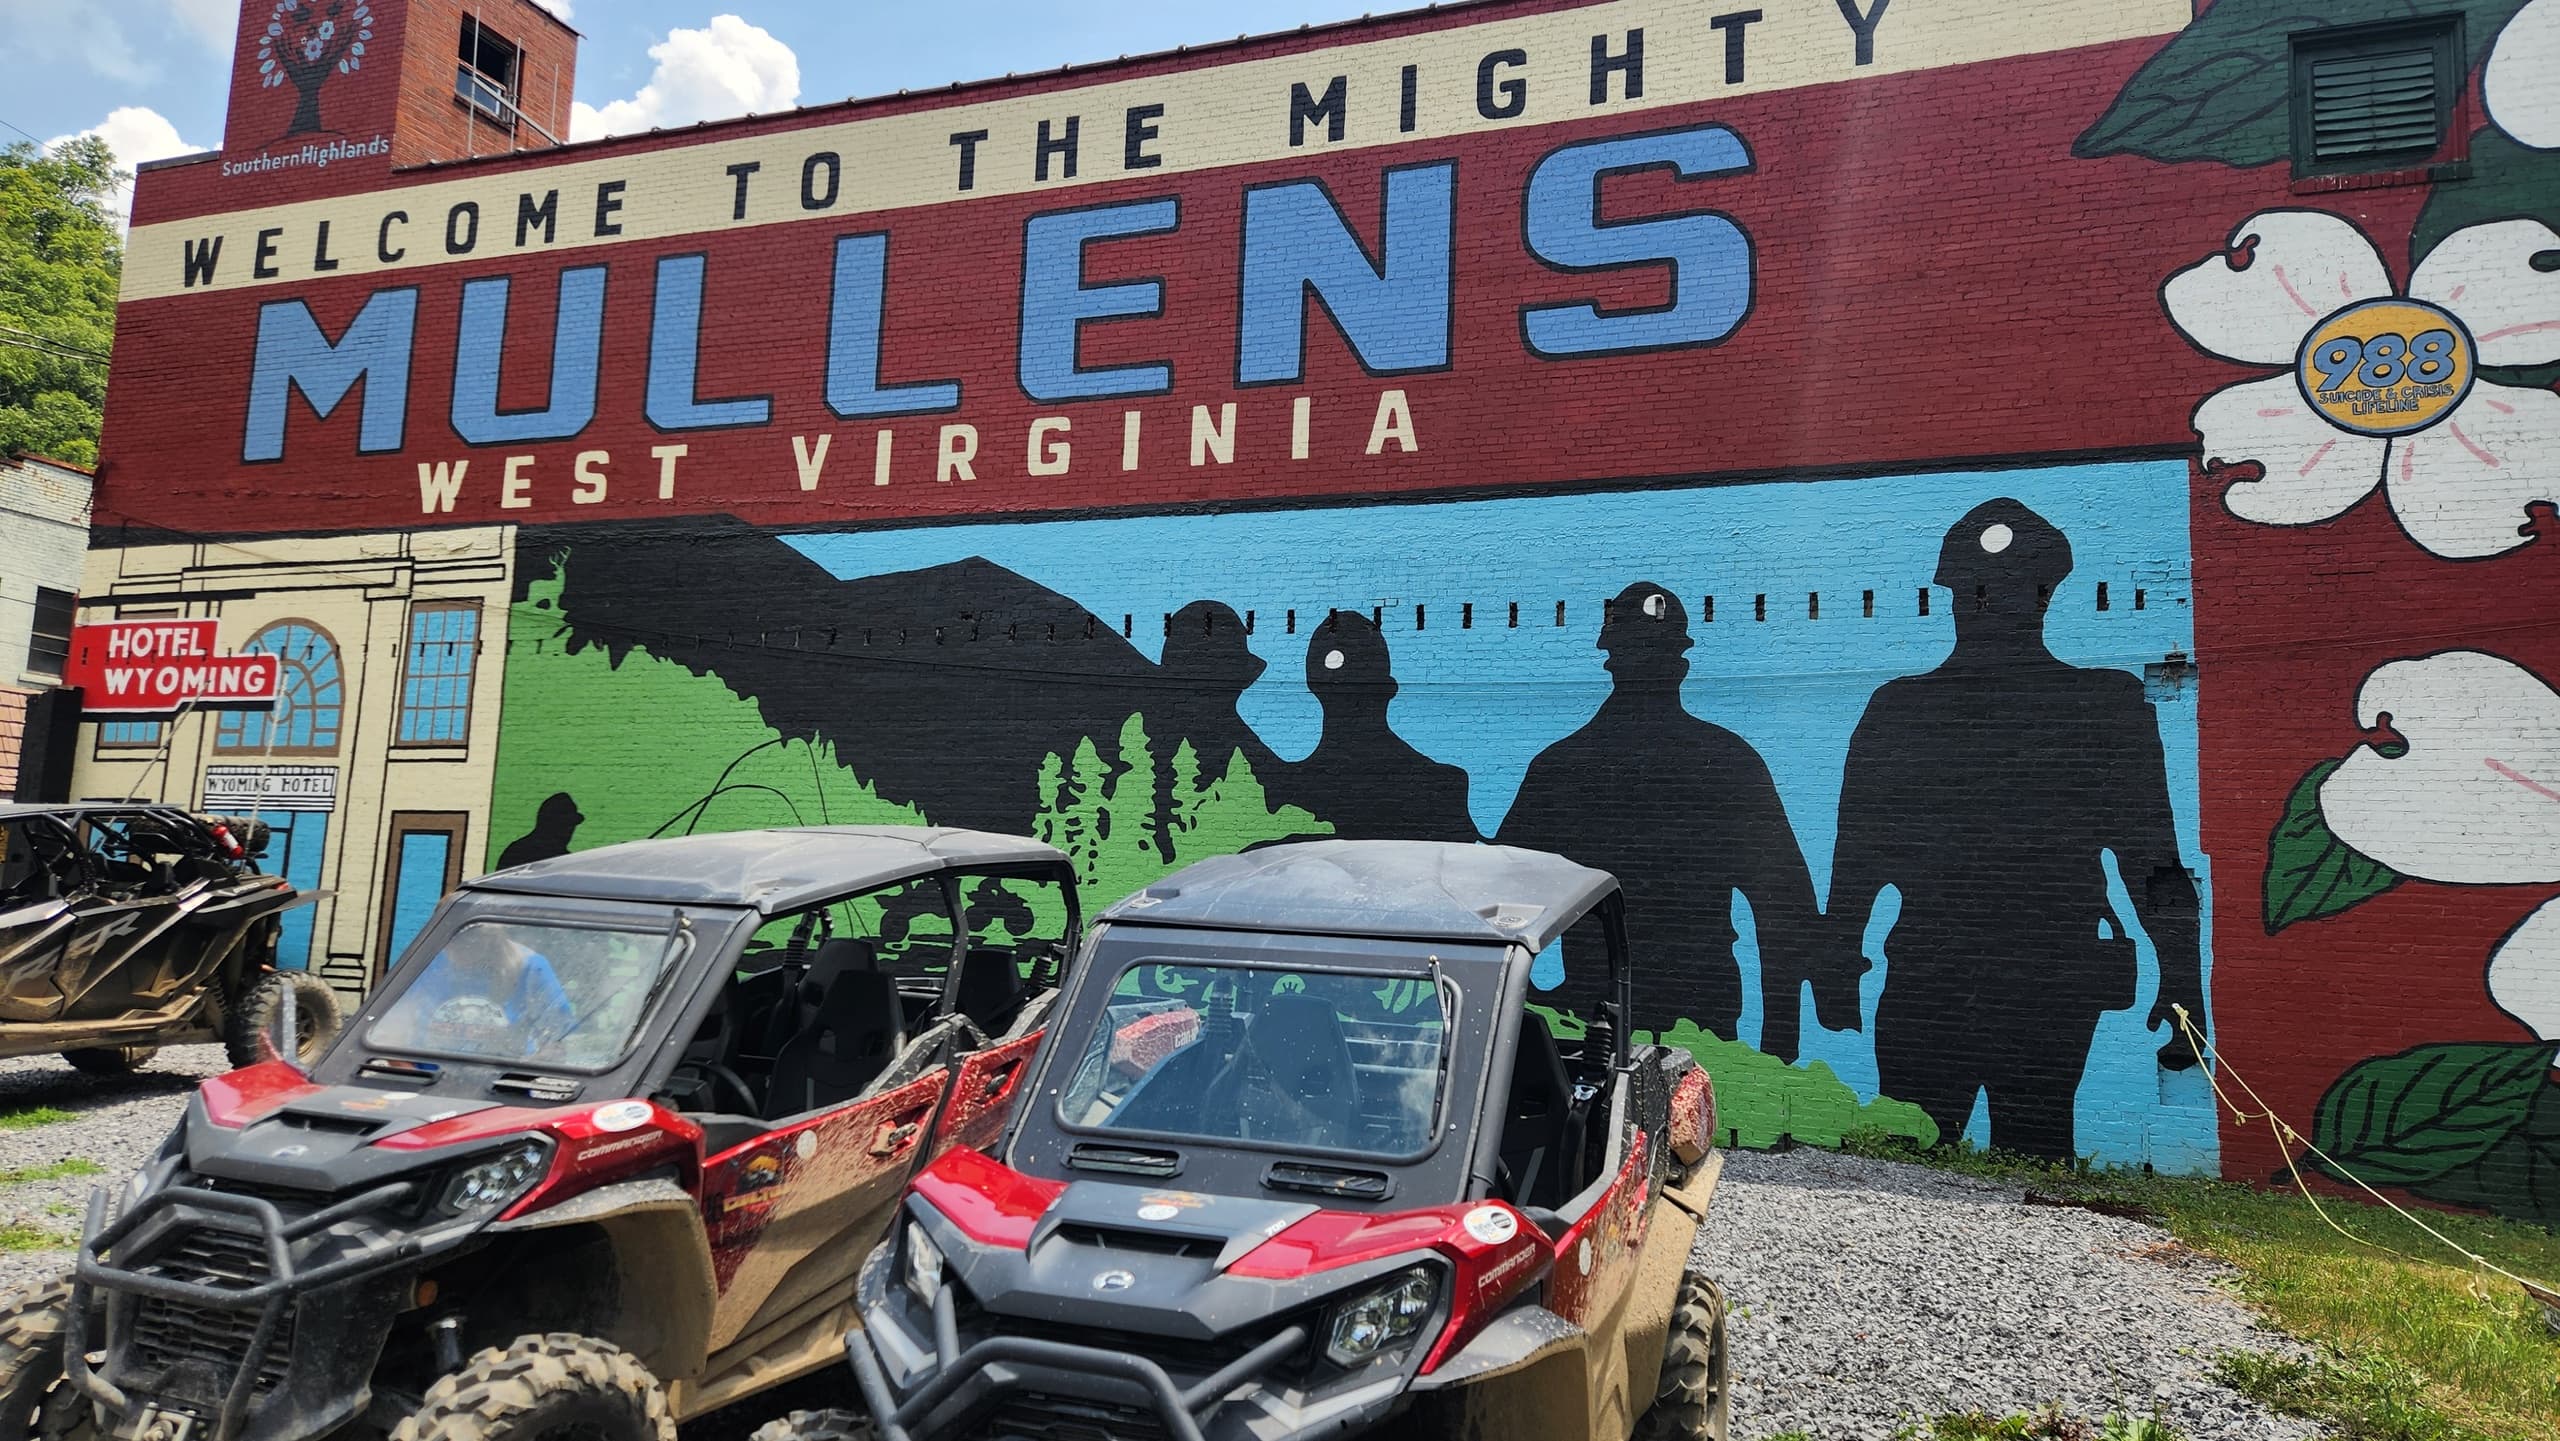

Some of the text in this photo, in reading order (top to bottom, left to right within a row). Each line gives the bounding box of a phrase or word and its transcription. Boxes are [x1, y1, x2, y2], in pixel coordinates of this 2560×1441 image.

[183, 0, 1890, 288] WELCOME TO THE MIGHTY
[241, 121, 1758, 465] MULLENS
[2313, 328, 2456, 392] 988
[2318, 384, 2454, 404] SUICIDE & CRISIS
[2351, 399, 2419, 415] LIFELINE
[417, 389, 1420, 514] WEST VIRGINIA
[108, 627, 206, 658] HOTEL
[104, 665, 266, 695] WYOMING
[207, 776, 331, 793] WYOMING HOTEL
[577, 1130, 664, 1161] COMMANDER
[1263, 1219, 1287, 1237] 700
[1478, 1242, 1536, 1289] COMMANDER
